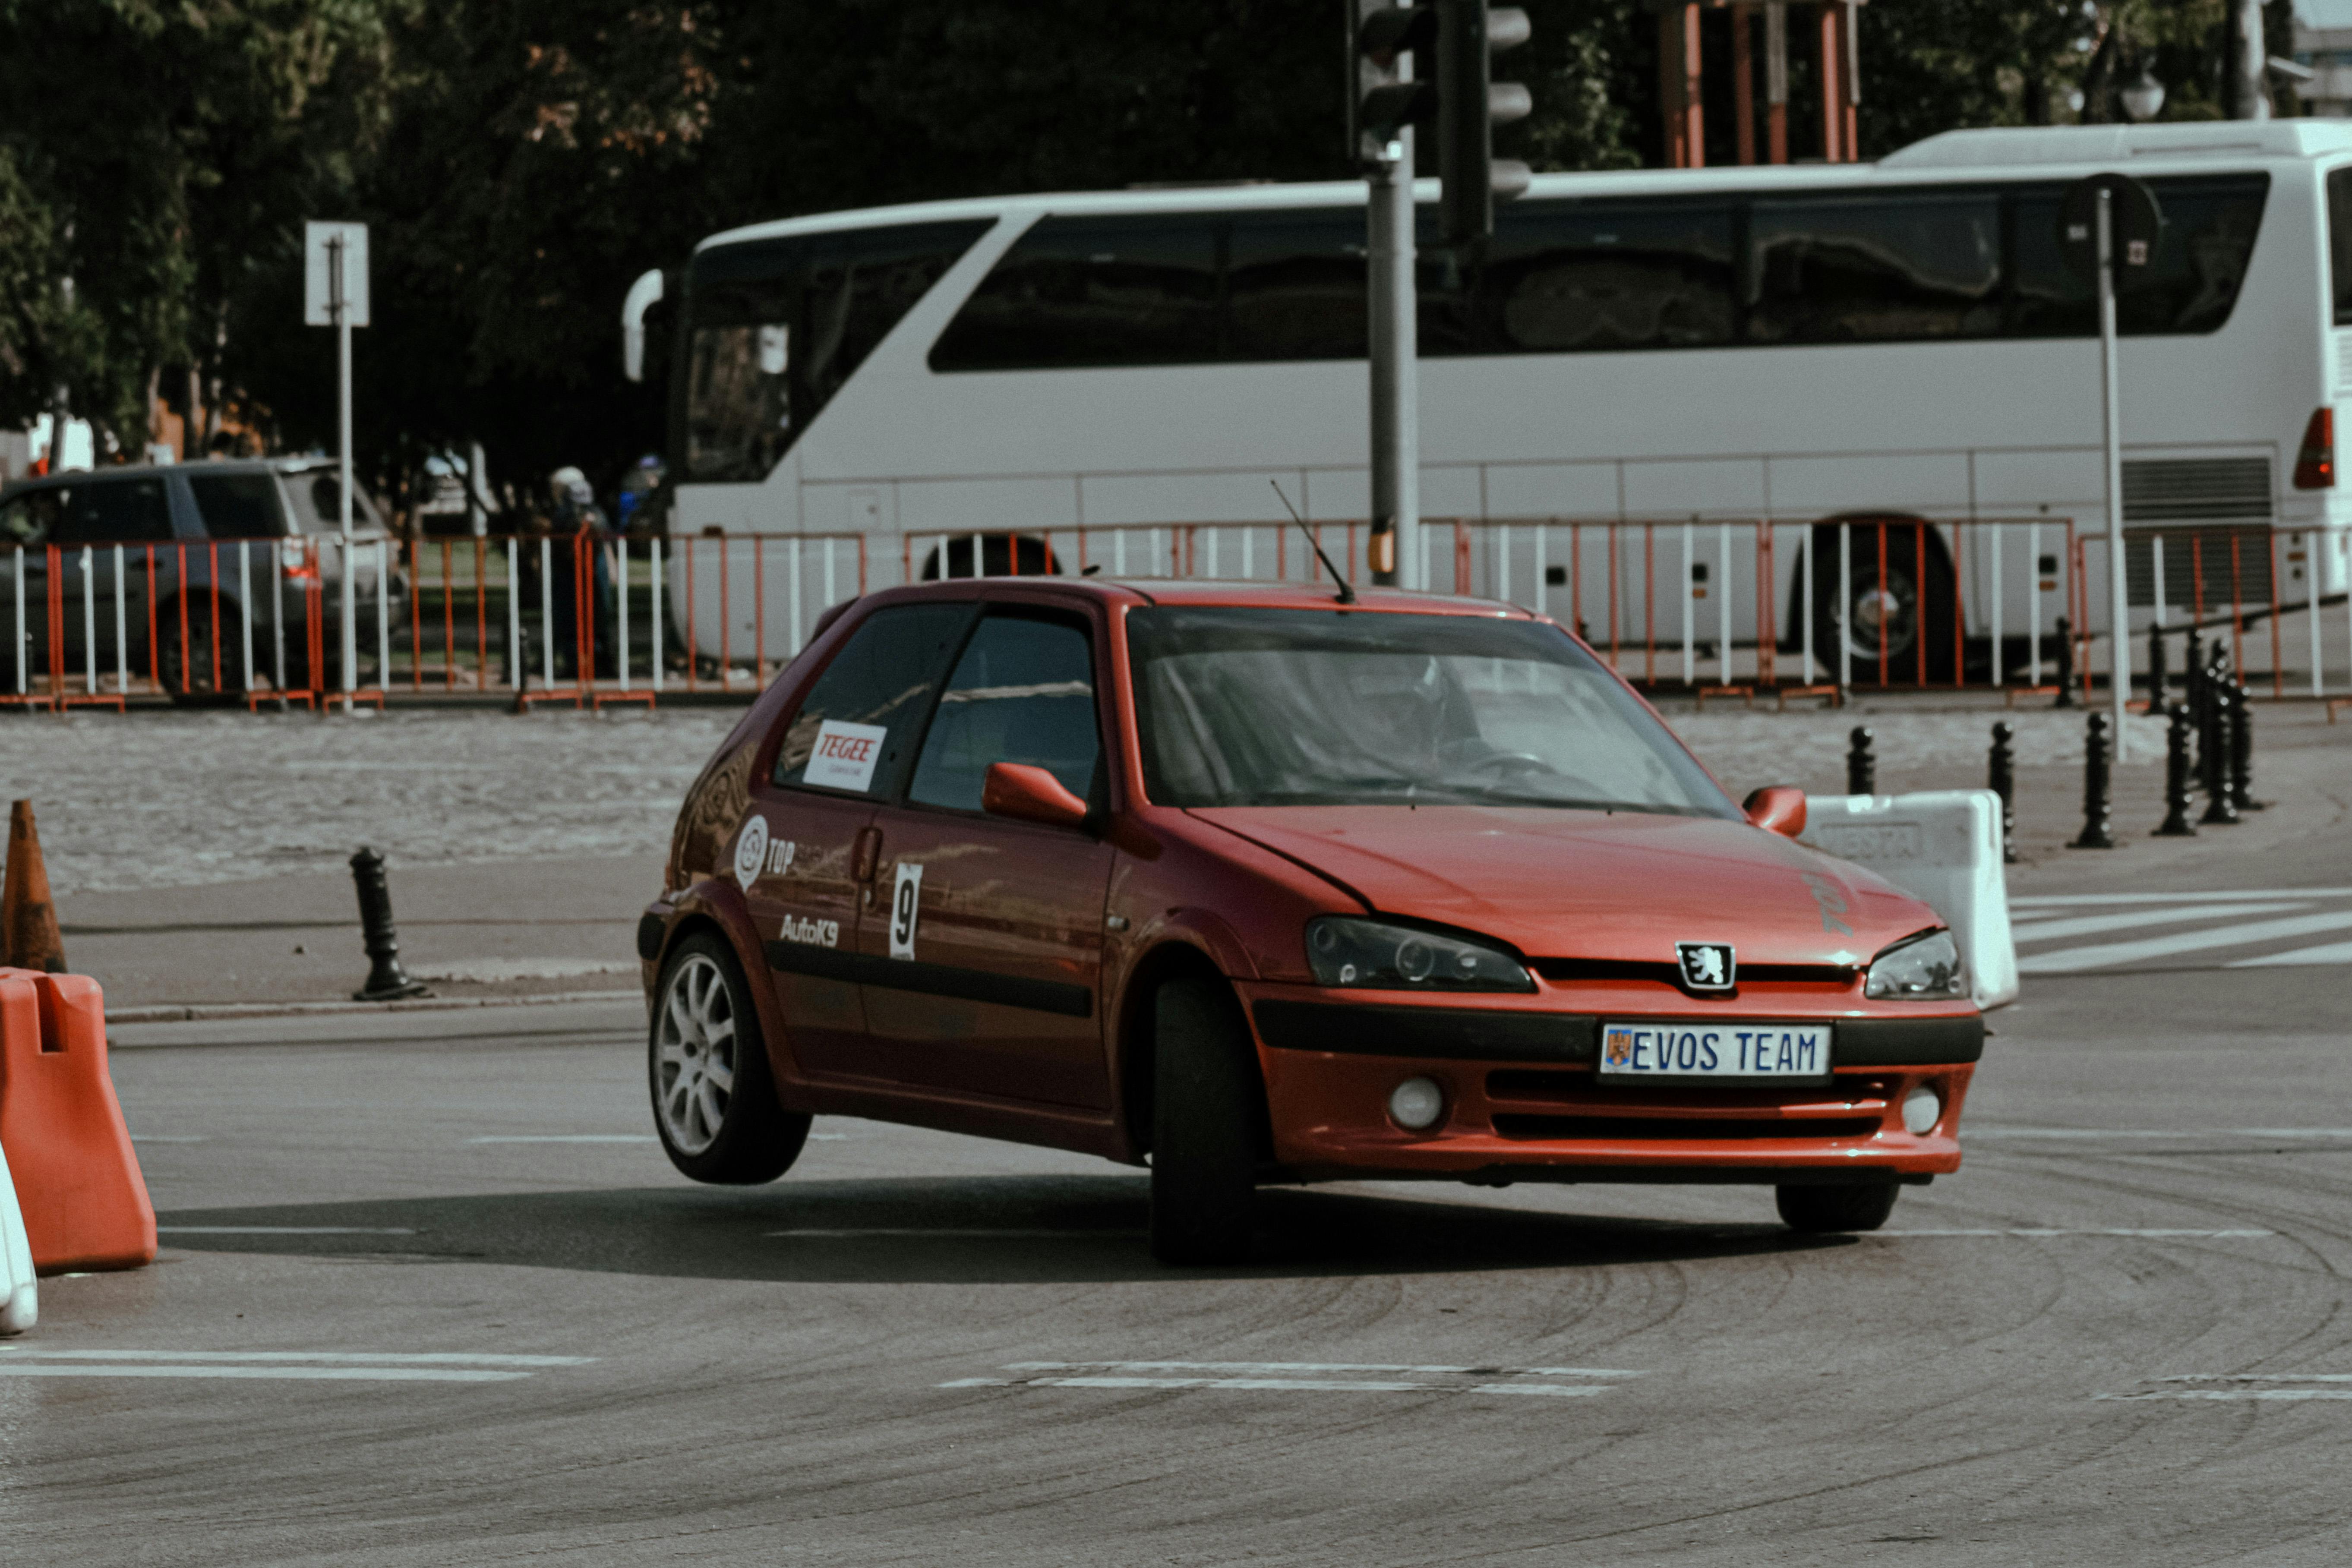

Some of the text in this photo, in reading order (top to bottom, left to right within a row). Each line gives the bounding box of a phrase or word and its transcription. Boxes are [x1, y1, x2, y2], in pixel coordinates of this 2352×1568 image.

[819, 733, 876, 762] TEGEE
[767, 839, 795, 875] TOP
[897, 879, 914, 945] 9
[780, 914, 839, 947] AutoK9
[1632, 1032, 1816, 1071] EVOS TEAM
